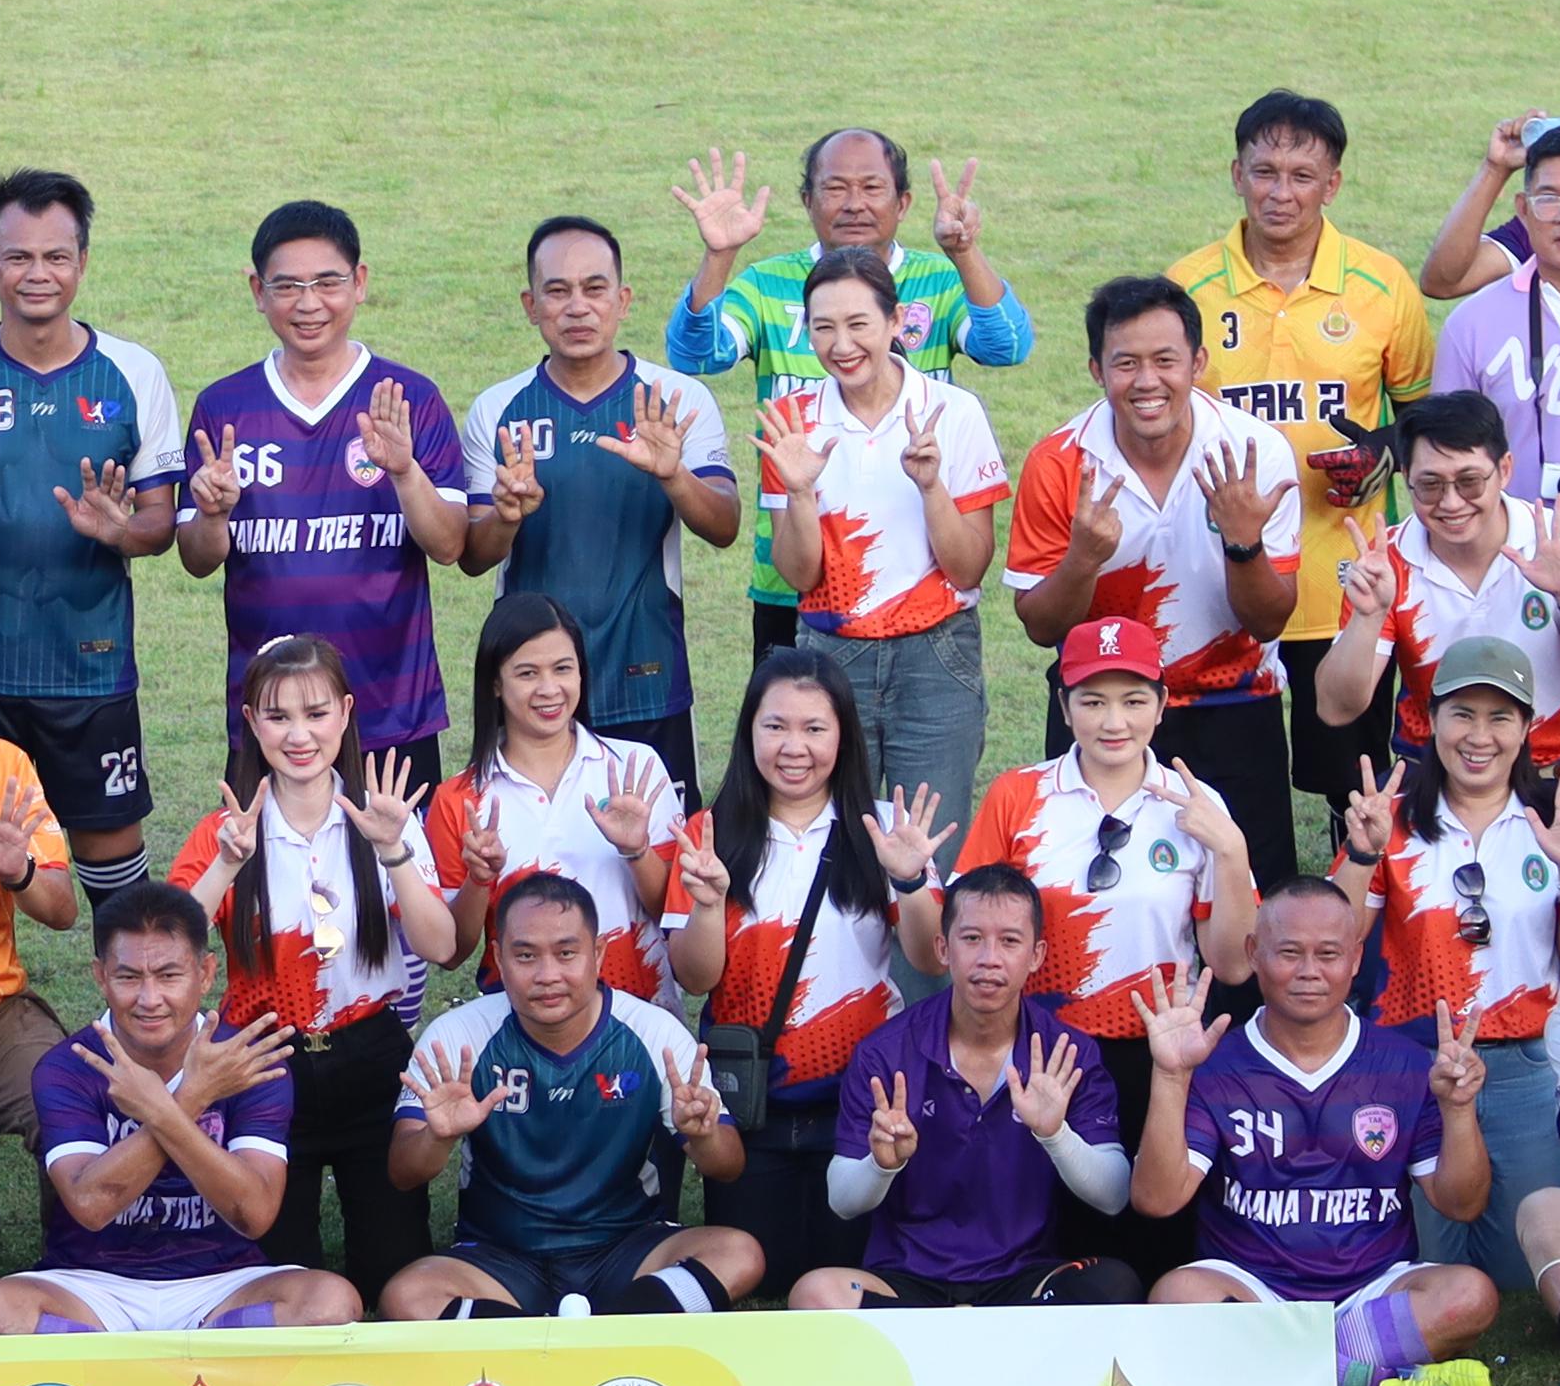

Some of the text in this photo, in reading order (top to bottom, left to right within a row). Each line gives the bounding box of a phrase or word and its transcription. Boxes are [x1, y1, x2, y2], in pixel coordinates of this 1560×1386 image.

[1221, 311, 1240, 349] 3
[1220, 379, 1347, 423] TAK 2
[234, 442, 282, 489] 66
[305, 514, 364, 553] TREE
[100, 746, 138, 797] 23
[1228, 1108, 1284, 1160] 34
[161, 1195, 216, 1231] TREE
[1309, 1187, 1372, 1226] TREE
